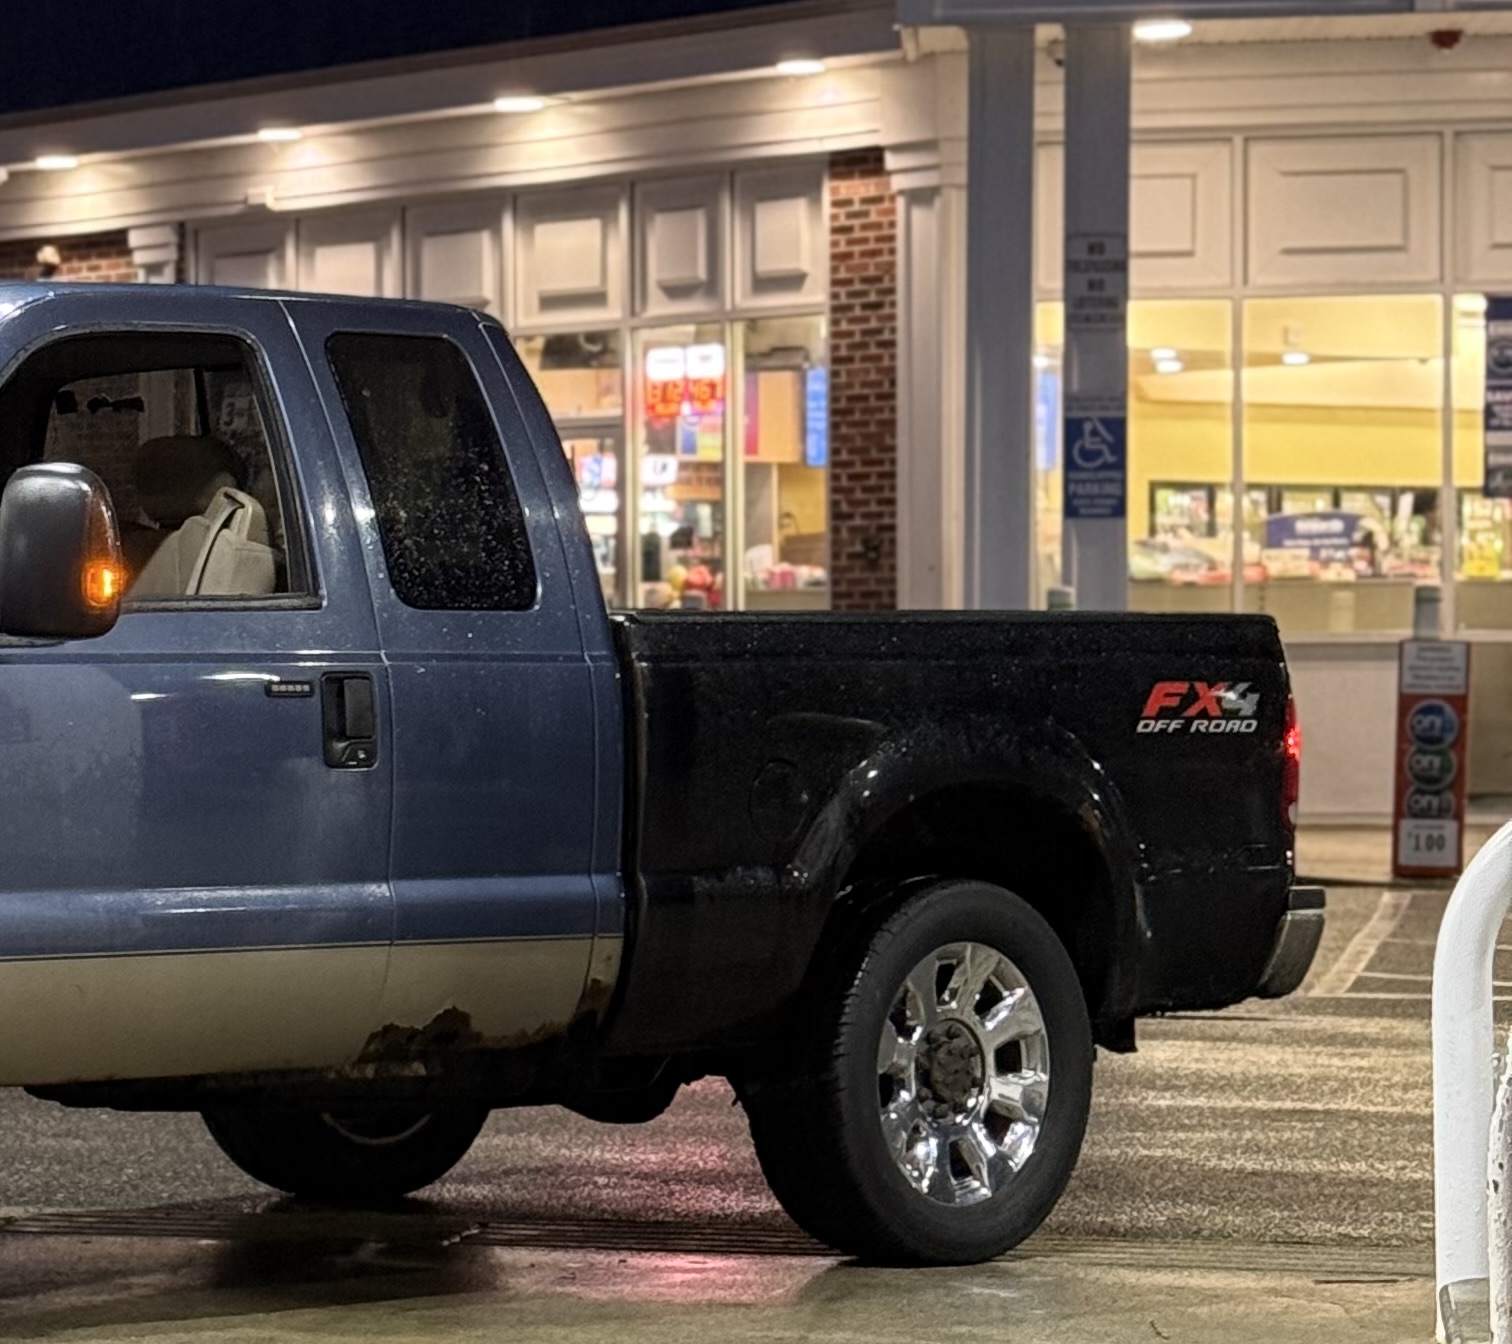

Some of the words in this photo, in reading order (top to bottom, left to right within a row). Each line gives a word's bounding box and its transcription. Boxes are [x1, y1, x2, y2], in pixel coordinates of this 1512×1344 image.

[1141, 680, 1261, 717] FX4
[1136, 719, 1185, 734] OFF
[1189, 719, 1258, 734] ROAD
